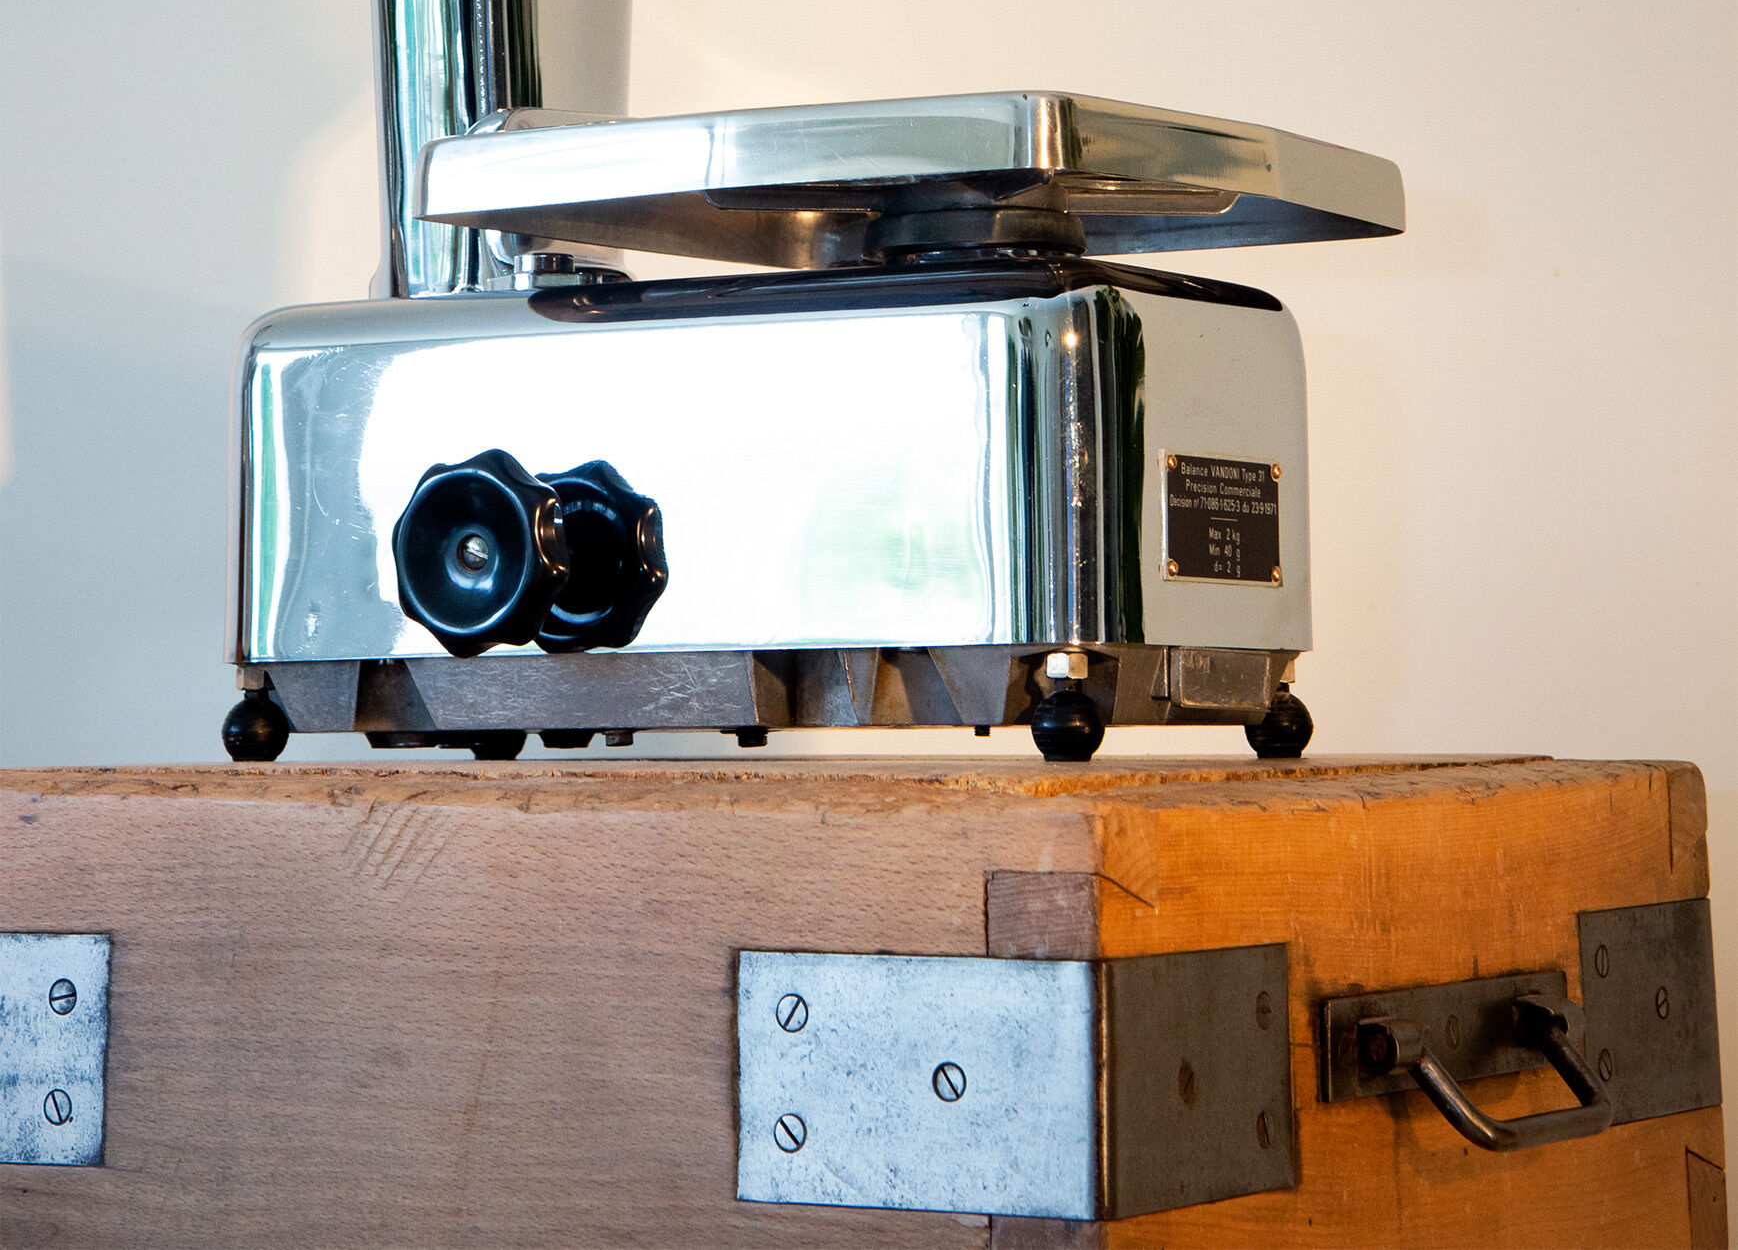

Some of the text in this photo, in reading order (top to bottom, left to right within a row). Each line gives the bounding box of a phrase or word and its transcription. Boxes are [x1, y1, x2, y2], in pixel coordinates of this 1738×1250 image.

[1181, 462, 1265, 484] Balance VANDONI Type 31
[1220, 483, 1261, 498] Commerciale
[1242, 502, 1250, 513] du
